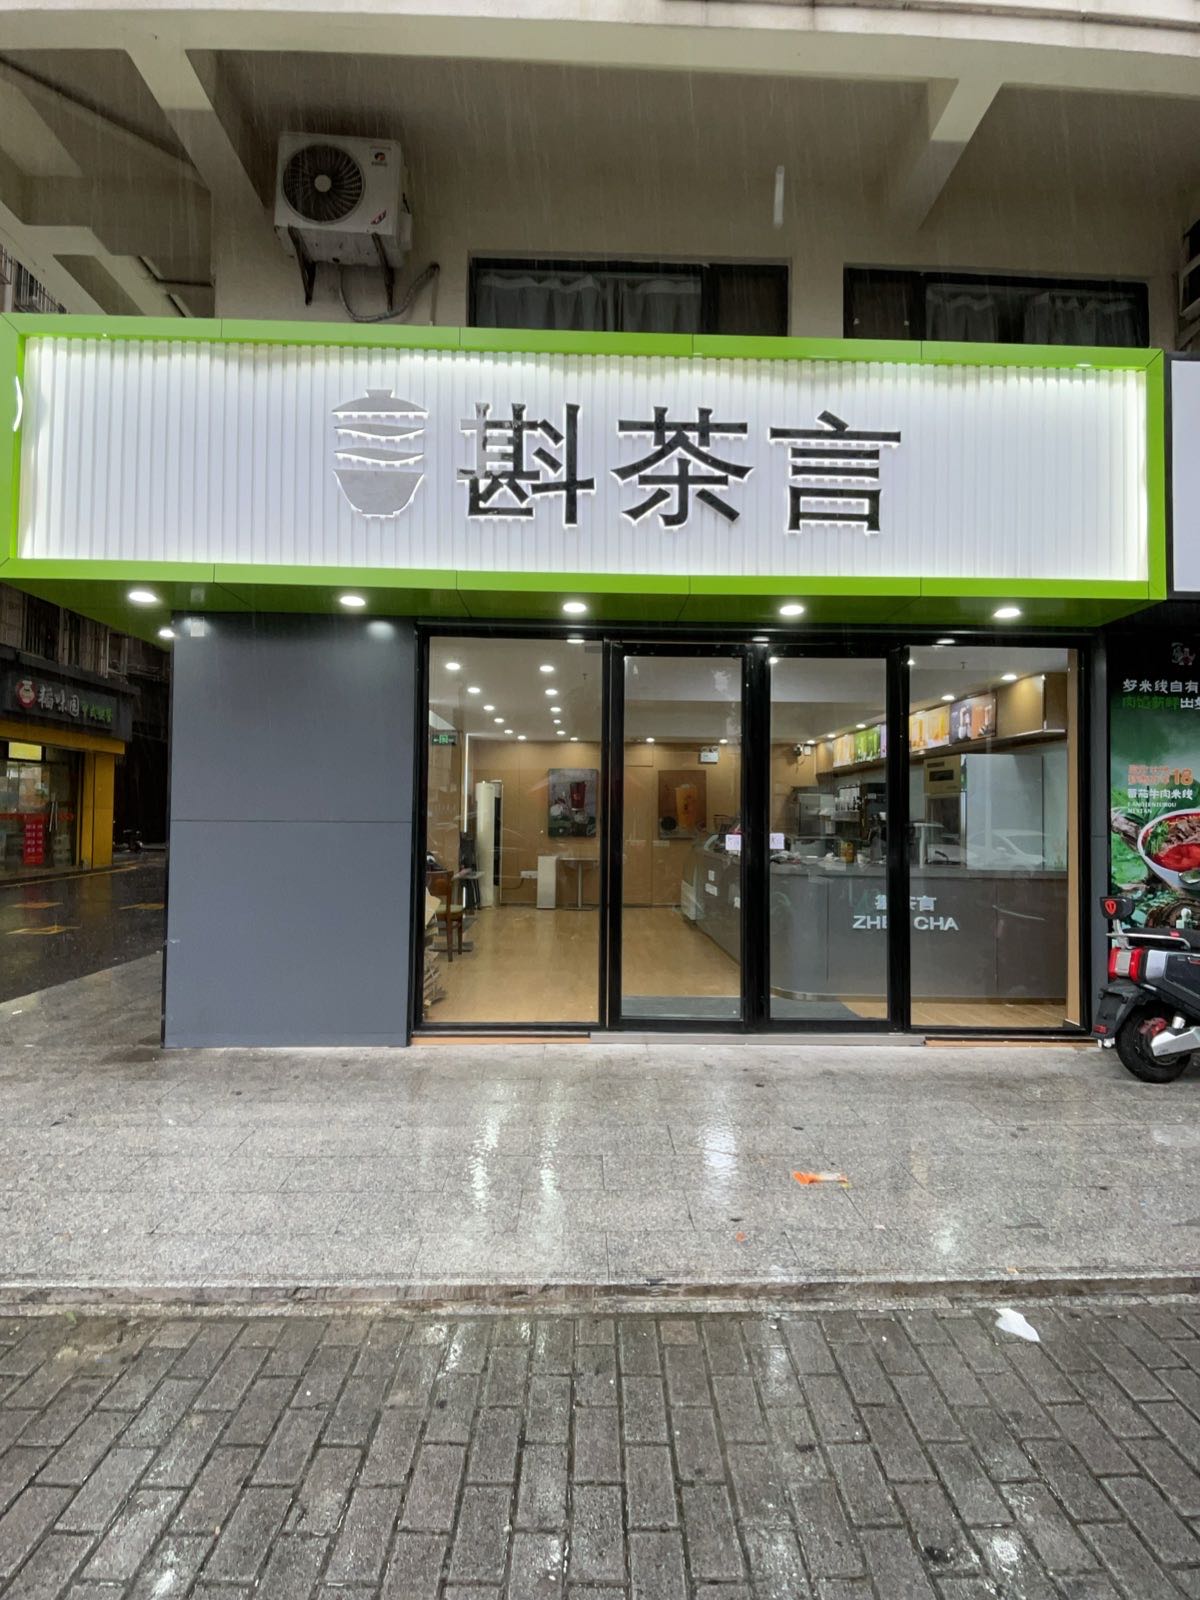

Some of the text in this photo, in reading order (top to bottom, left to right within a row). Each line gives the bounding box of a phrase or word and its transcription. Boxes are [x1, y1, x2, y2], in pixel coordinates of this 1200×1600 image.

[457, 402, 901, 533] 斟茶言
[1127, 788, 1193, 800] 番茄牛肉米线
[913, 916, 960, 931] CHA
